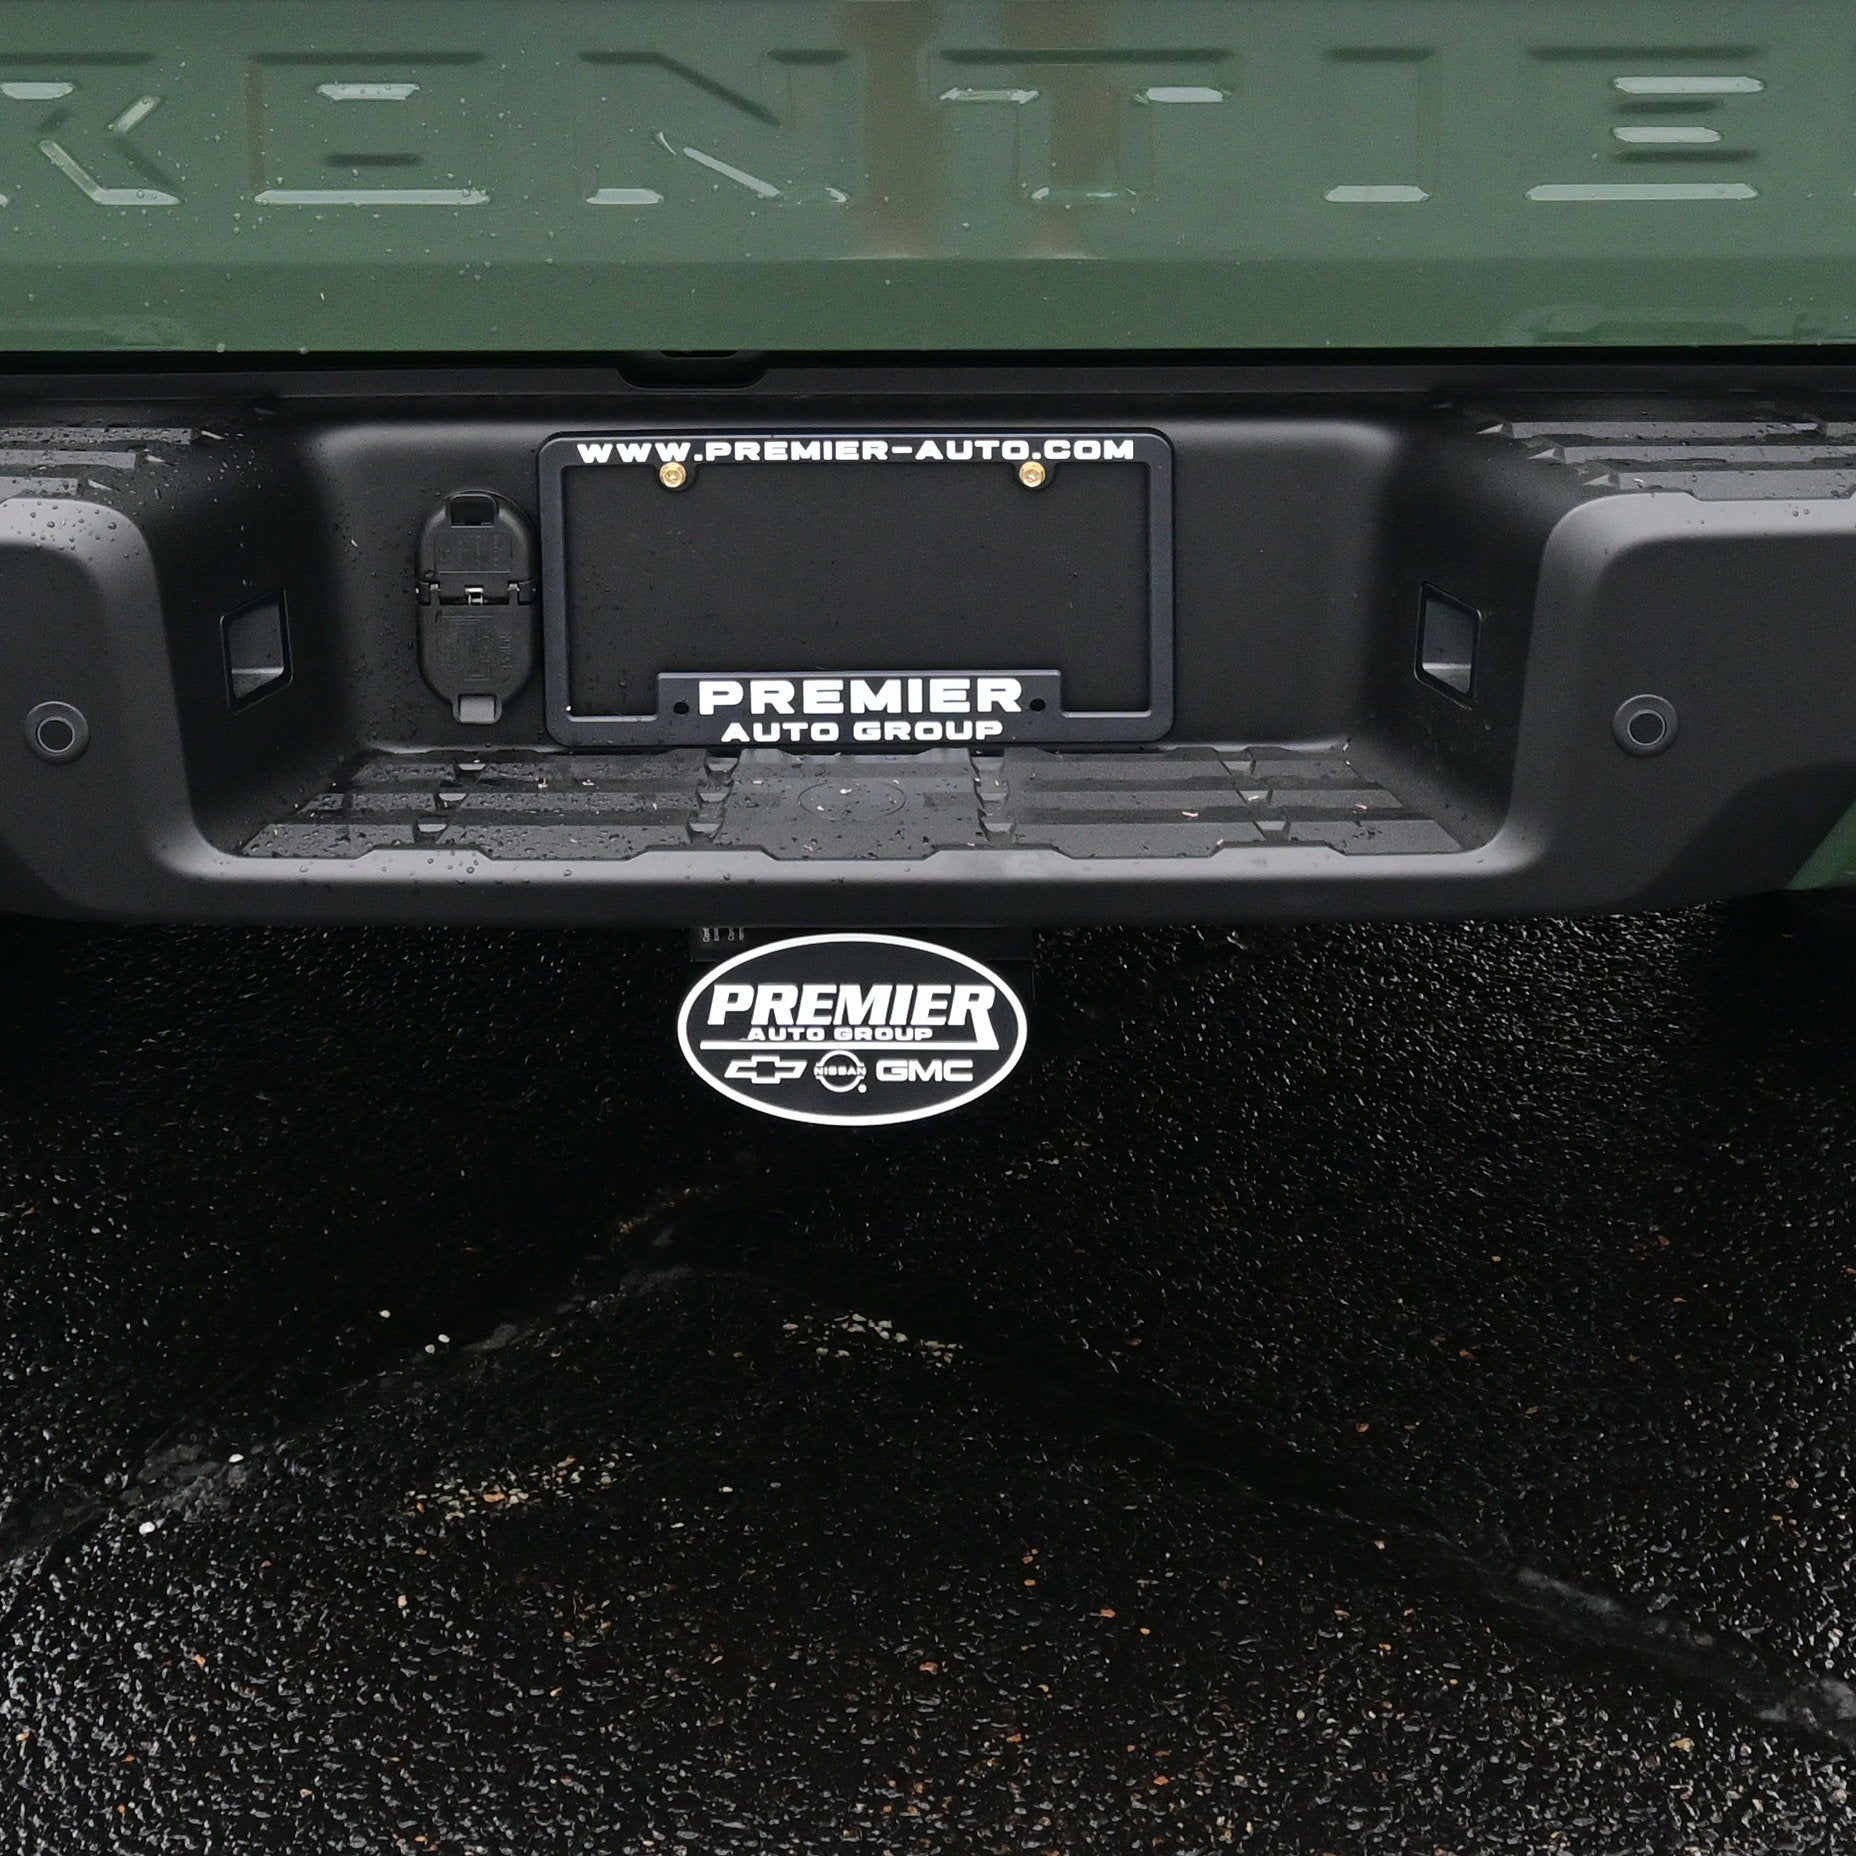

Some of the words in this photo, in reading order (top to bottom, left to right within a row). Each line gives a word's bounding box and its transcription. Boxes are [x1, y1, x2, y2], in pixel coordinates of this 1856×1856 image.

[576, 439, 1135, 464] WWW.PREMIER-AUTO.COM
[697, 677, 1023, 717] PREMIER
[720, 721, 841, 744] AUTO
[852, 719, 1004, 742] GROUP
[707, 982, 997, 1028] PREMIER
[746, 1027, 824, 1042] AUTO
[832, 1027, 934, 1042] GROUP
[813, 1065, 868, 1077] NISSAN
[875, 1058, 974, 1084] GMC
